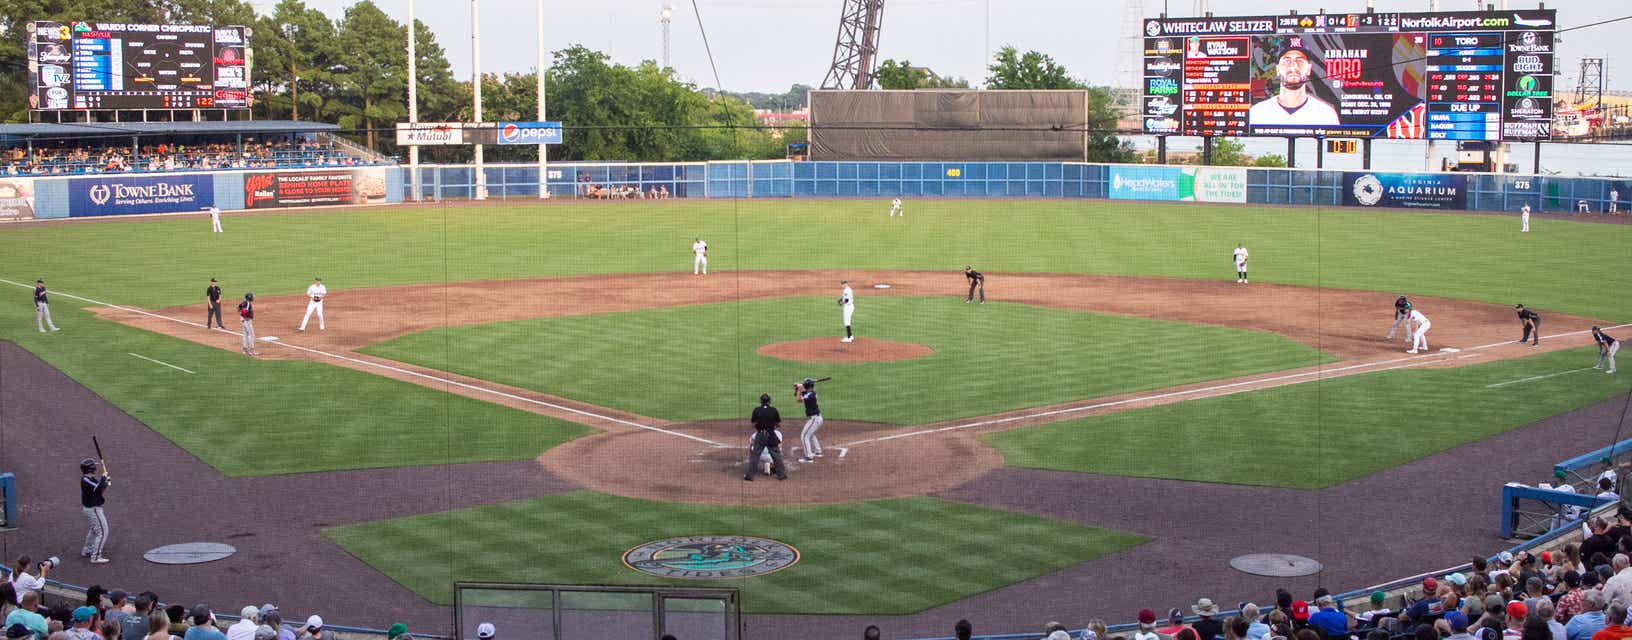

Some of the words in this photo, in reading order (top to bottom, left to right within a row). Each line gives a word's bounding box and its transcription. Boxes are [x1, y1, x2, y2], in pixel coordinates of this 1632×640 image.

[1162, 22, 1227, 33] WHITECLAW
[1228, 21, 1273, 32] SELTZER
[1401, 16, 1509, 29] NorfolkAirport.com
[96, 23, 127, 31] WARDS
[127, 24, 160, 32] CORNER
[60, 25, 70, 40] 3
[1455, 37, 1479, 45] TORO
[1324, 49, 1368, 58] ABRAHAM
[1517, 56, 1540, 64] BUD
[1324, 59, 1362, 79] TORO
[1513, 63, 1543, 72] LIGHT
[1149, 79, 1178, 87] ROYAL
[1149, 87, 1178, 95] FARMS
[416, 132, 452, 141] Mutual
[521, 126, 556, 139] pepsi
[946, 168, 961, 177] 400
[1514, 180, 1530, 189] 375
[1388, 186, 1456, 195] AQUARIUM
